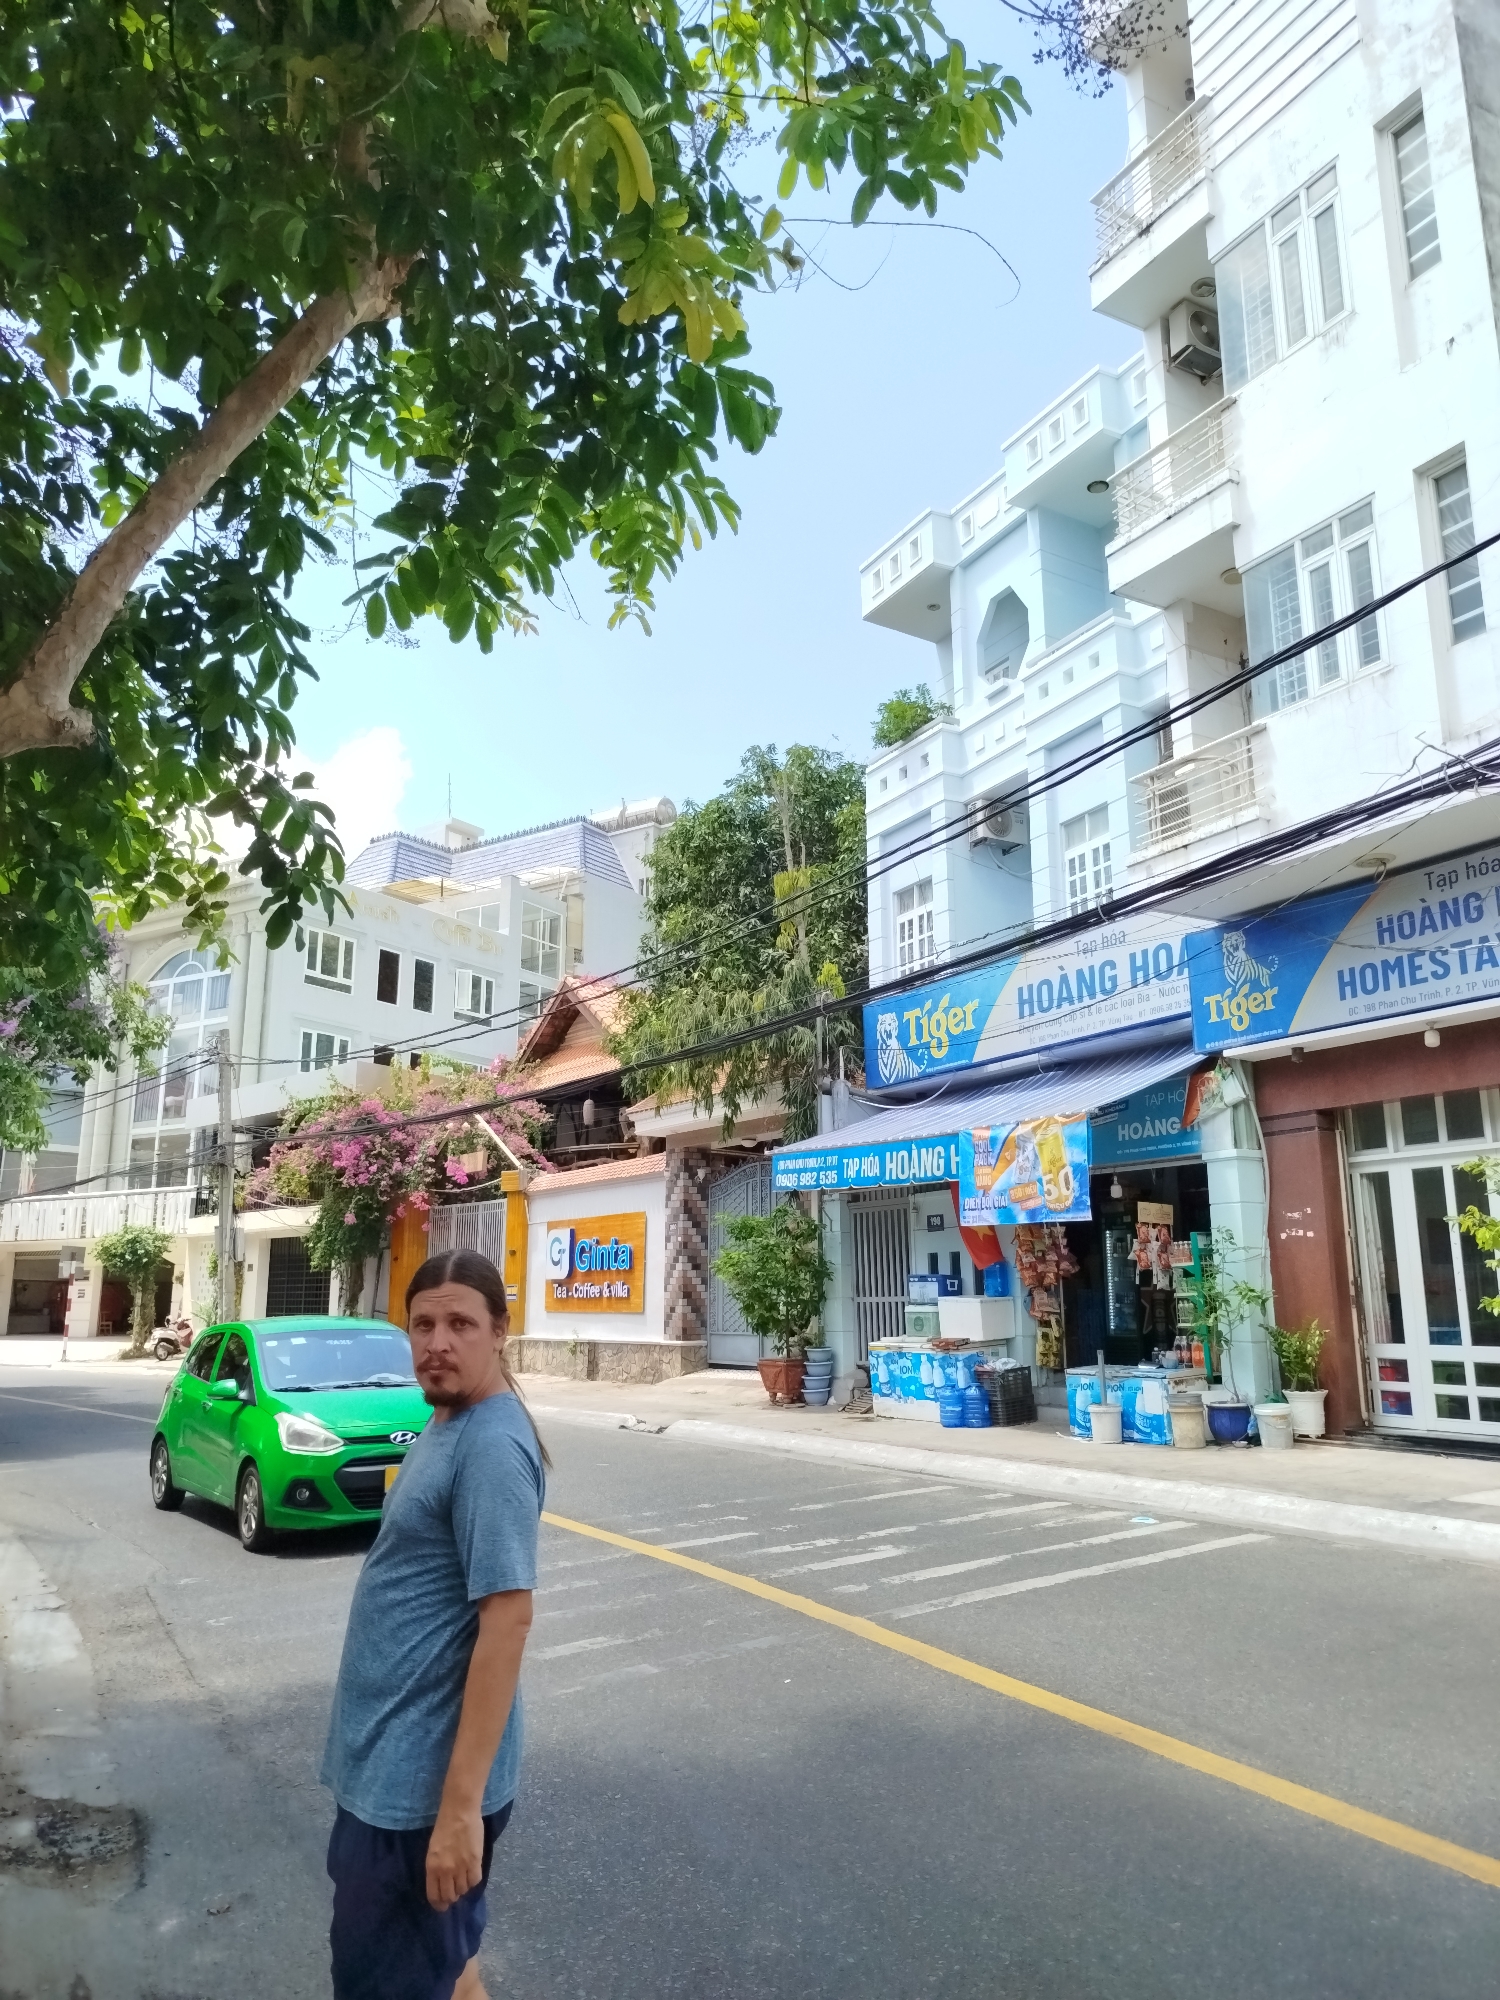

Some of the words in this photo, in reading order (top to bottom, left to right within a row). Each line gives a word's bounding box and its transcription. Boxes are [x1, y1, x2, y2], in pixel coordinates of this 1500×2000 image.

[1424, 869, 1459, 893] Tạp
[1465, 855, 1500, 881] hóa
[1376, 891, 1485, 945] HOÀNG
[1101, 928, 1126, 948] hóa
[1017, 959, 1118, 1020] HOÀNG
[1203, 983, 1279, 1031] Tiger
[1363, 1002, 1377, 1013] 198
[1378, 998, 1399, 1011] Phan
[1401, 995, 1417, 1006] Chu
[903, 993, 980, 1058] Tiger
[1117, 1115, 1182, 1142] HOÀNG
[775, 1172, 799, 1187] 0906
[800, 1171, 818, 1186] 982
[819, 1170, 838, 1185] 535
[842, 1158, 860, 1183] TẠP
[860, 1152, 881, 1178] HÓA
[885, 1143, 945, 1181] HOÀNG
[575, 1236, 633, 1273] Ginta
[553, 1283, 568, 1299] Tea
[572, 1282, 601, 1299] Coffee
[602, 1282, 611, 1298] &
[610, 1280, 629, 1298] villa
[1080, 1382, 1095, 1392] ION
